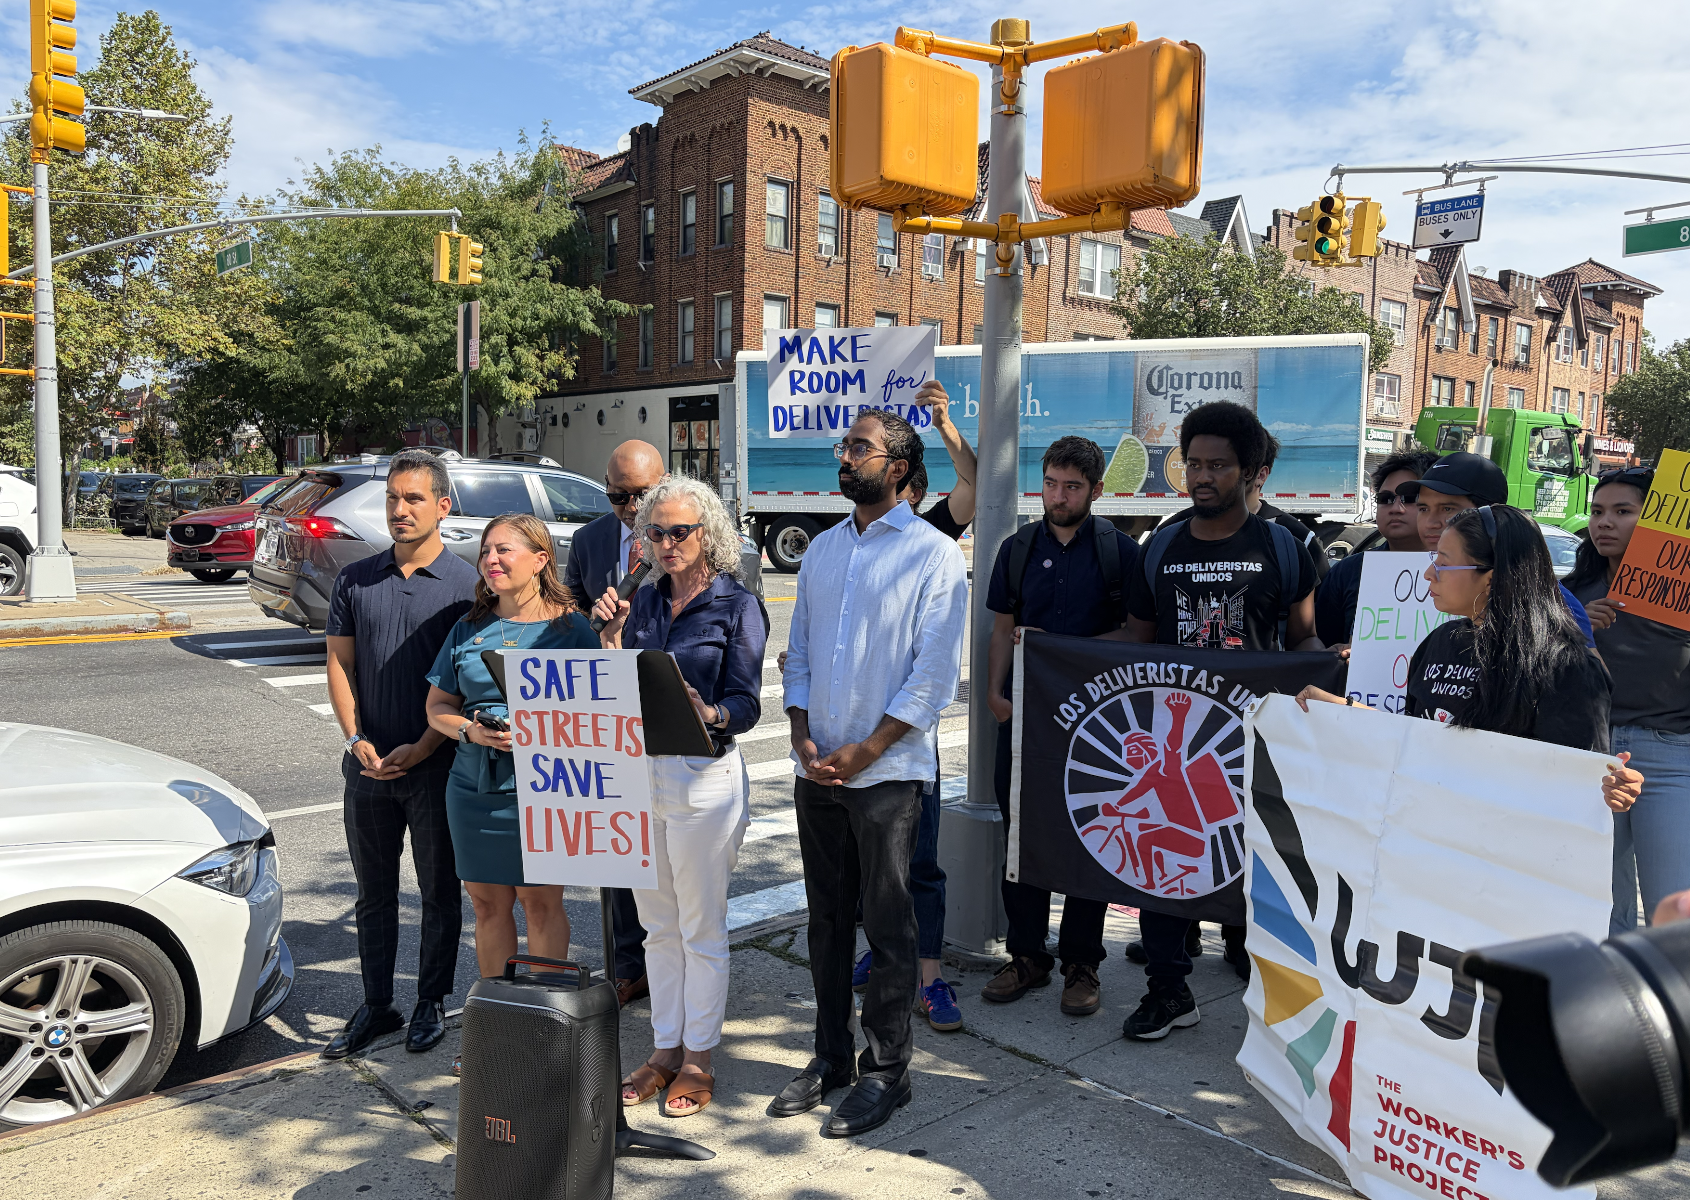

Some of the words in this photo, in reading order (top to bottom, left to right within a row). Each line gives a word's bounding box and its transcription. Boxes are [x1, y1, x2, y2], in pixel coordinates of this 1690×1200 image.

[1418, 214, 1449, 227] BUSES
[1453, 209, 1478, 222] ONLY
[1434, 202, 1452, 212] BUS
[1454, 198, 1479, 209] LANE
[779, 333, 872, 366] MAKE
[789, 368, 866, 396] ROOM
[881, 369, 926, 403] for
[1146, 363, 1244, 400] Corona
[1593, 438, 1609, 451] WINES
[1614, 441, 1635, 454] LIQUORS
[1163, 564, 1184, 574] LOS
[1185, 561, 1263, 572] DELIVERISTAS
[1191, 572, 1233, 583] UNIDOS
[1394, 569, 1431, 603] OU
[1177, 608, 1193, 620] HAVE
[519, 657, 617, 702] SAFE
[1423, 663, 1443, 681] LOS
[1053, 692, 1086, 731] LOS
[1084, 662, 1224, 702] DELIVERISTAS
[1431, 681, 1474, 699] UNIDOS
[514, 709, 643, 758] STREETS
[530, 753, 622, 800] SAVE
[525, 805, 651, 868] LIVES!
[1376, 1073, 1402, 1095] THE
[485, 1115, 516, 1144] JBL
[1377, 1092, 1526, 1171] WORKER'S
[1373, 1117, 1482, 1183] JUSTICE
